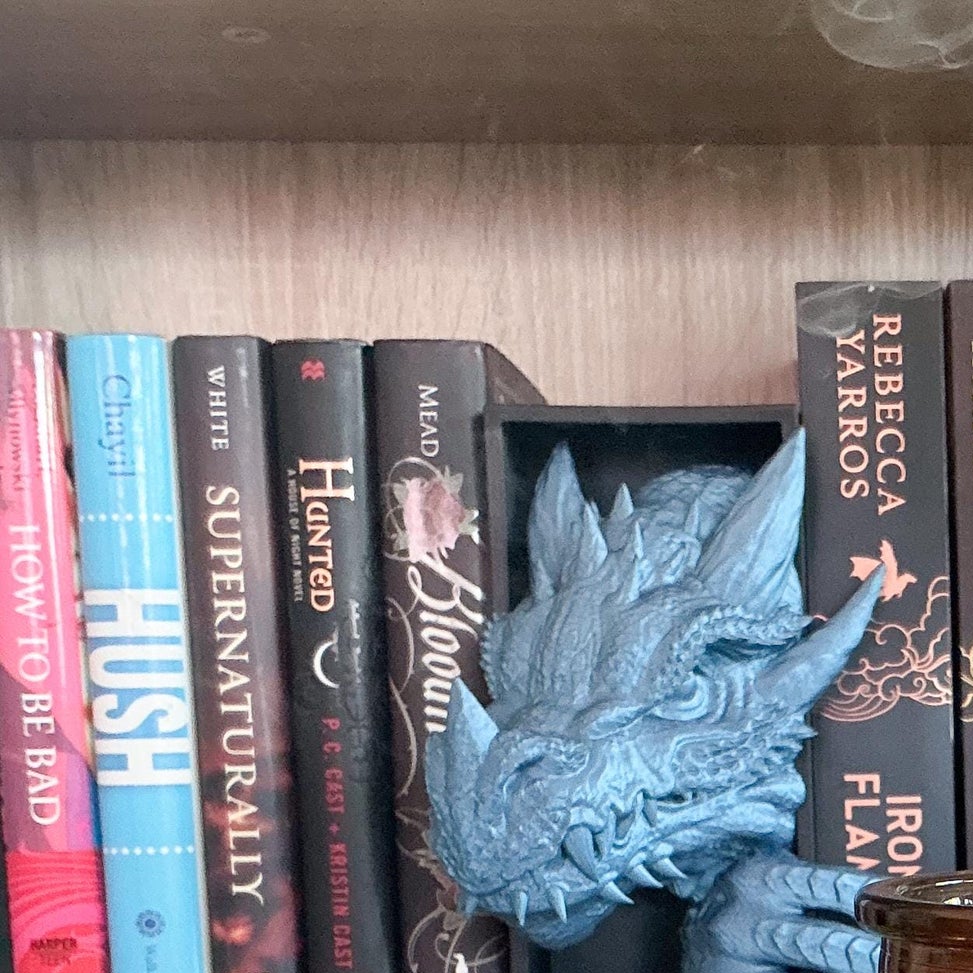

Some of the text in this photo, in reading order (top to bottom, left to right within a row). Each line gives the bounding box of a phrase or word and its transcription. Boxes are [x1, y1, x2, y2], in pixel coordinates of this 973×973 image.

[102, 374, 136, 478] Chayil
[205, 365, 230, 451] WHITE
[417, 384, 440, 458] MEAD
[836, 329, 870, 498] YARROS
[873, 314, 906, 516] REBECCA
[287, 479, 299, 513] HOUSE
[290, 533, 302, 566] NIGHT
[292, 569, 304, 602] NOVEL
[9, 525, 61, 826] HOW TO BE BAD
[84, 589, 193, 786] HUSH
[205, 484, 264, 906] SUPERNATURALLY
[324, 768, 345, 815] CAST
[329, 843, 351, 917] KRISTIN
[332, 925, 353, 969] CAST
